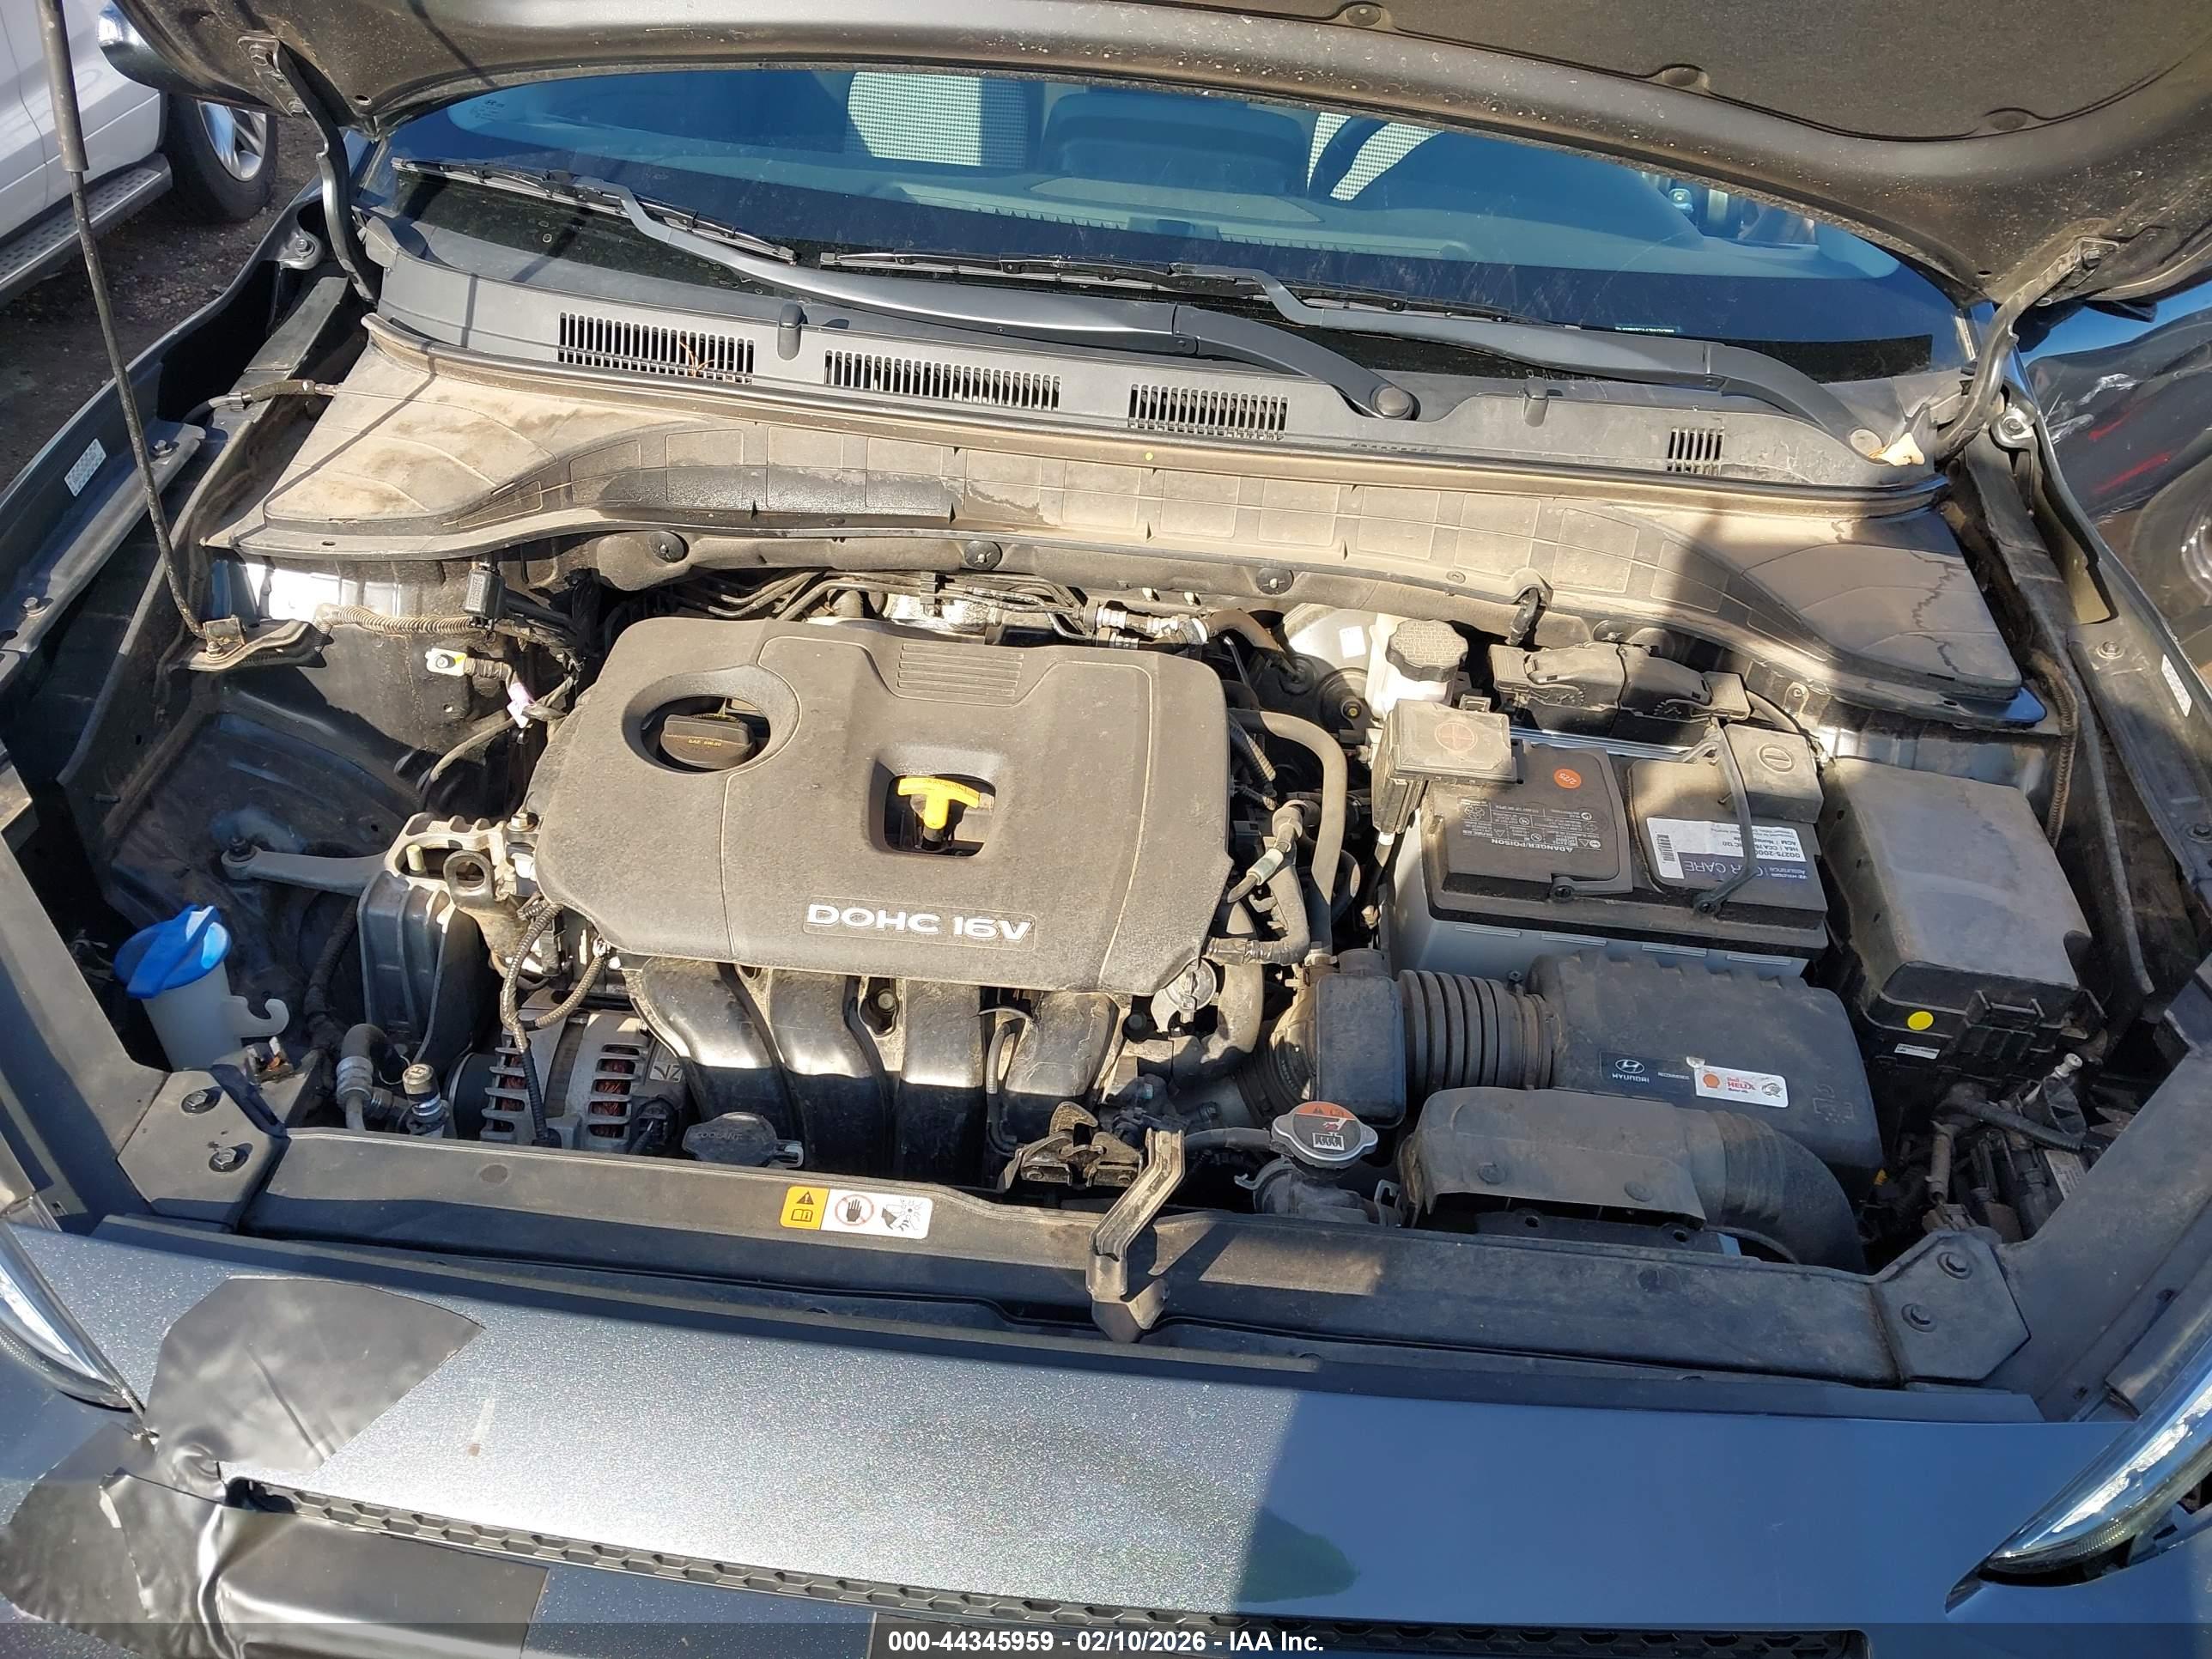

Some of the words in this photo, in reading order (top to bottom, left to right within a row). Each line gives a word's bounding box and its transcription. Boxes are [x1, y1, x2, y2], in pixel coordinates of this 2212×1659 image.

[1491, 838, 1565, 852] DANGER/POISON
[1683, 860, 1726, 874] CARE
[806, 902, 942, 935] DOHC
[954, 915, 1033, 942] 16V
[1612, 1073, 1650, 1084] HYUNDAI
[1727, 1081, 1757, 1091] HELIX
[695, 1132, 743, 1141] COOLANT
